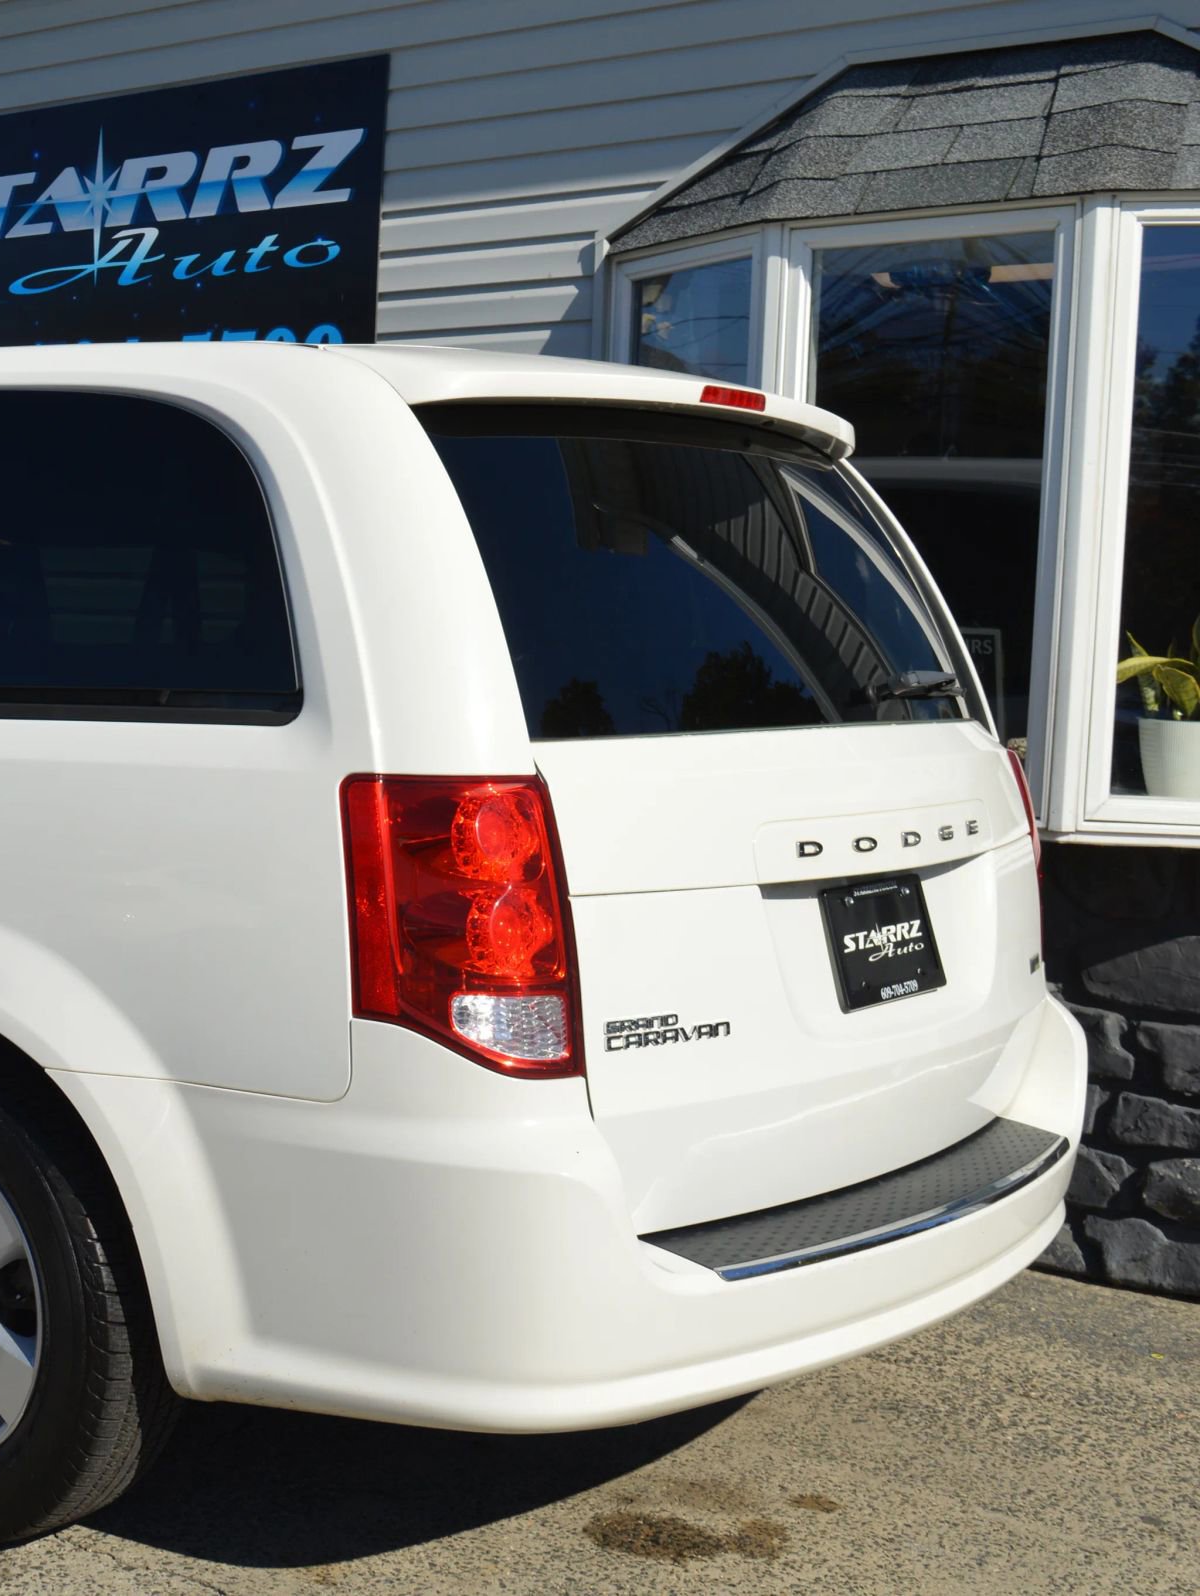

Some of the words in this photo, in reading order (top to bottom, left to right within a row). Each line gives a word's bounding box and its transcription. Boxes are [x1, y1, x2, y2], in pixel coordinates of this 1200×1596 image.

[8, 227, 342, 295] Auto
[796, 820, 979, 858] DODGE
[843, 919, 923, 954] STARRZ
[868, 942, 925, 962] Auto
[880, 979, 919, 1000] 609-704-5709
[604, 1013, 679, 1036] GRAND
[604, 1021, 731, 1053] CARAVAN
